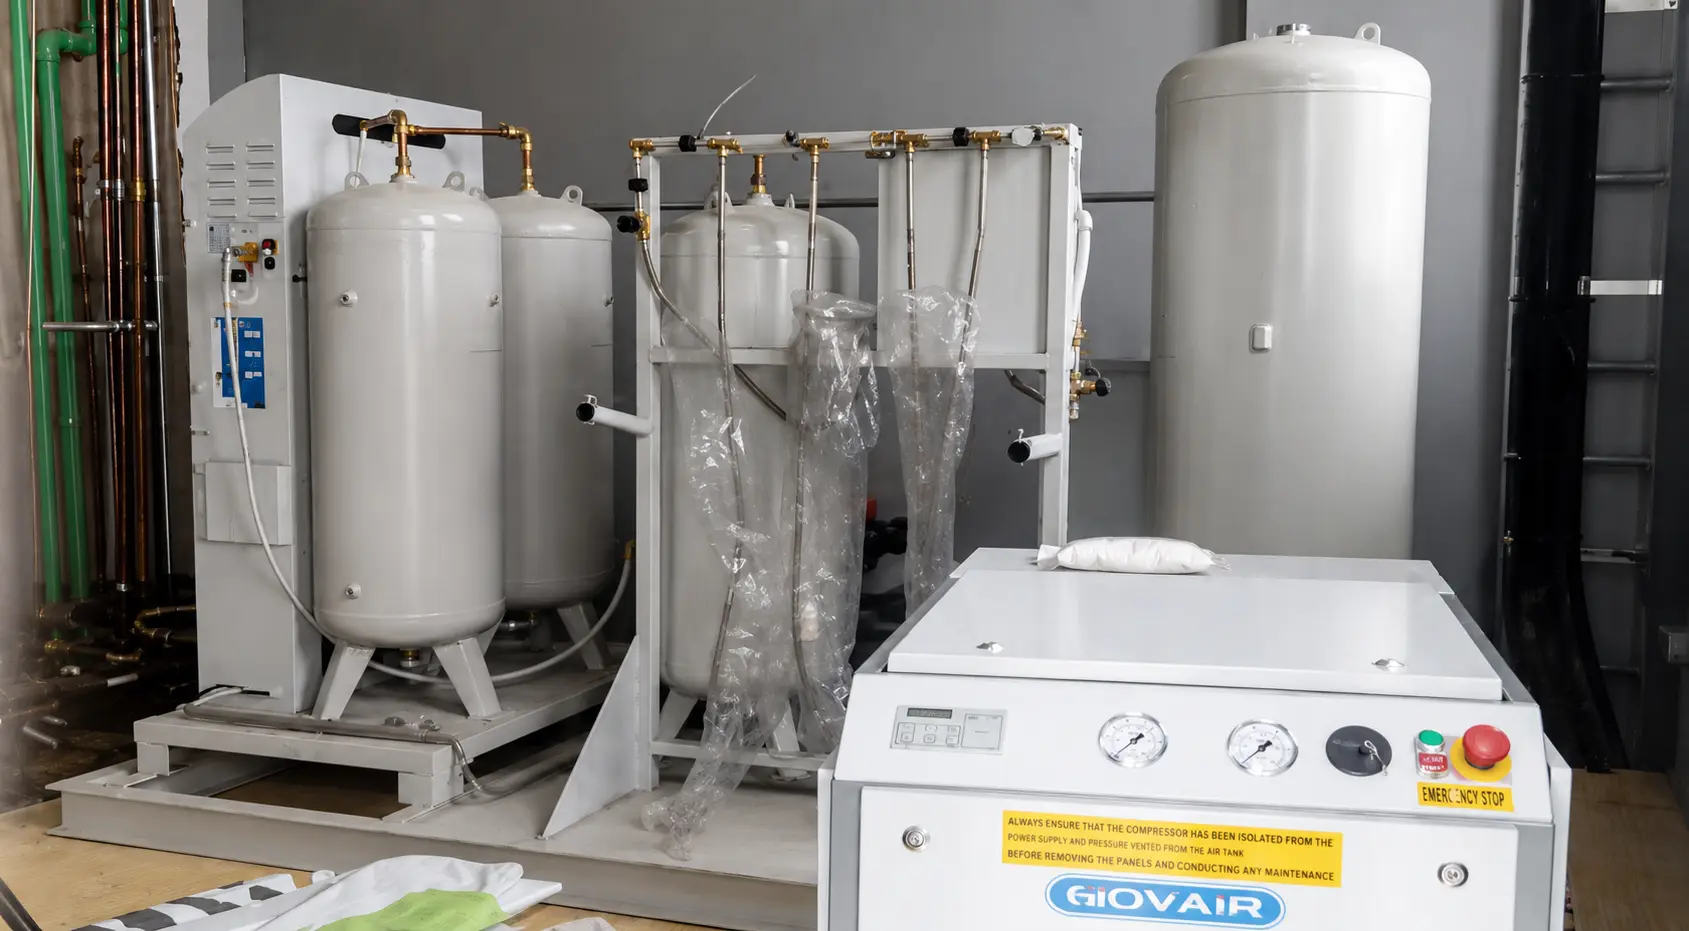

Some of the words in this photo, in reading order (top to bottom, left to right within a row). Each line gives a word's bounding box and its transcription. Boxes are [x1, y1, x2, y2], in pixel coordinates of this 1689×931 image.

[1481, 791, 1505, 806] STOP
[1008, 817, 1043, 828] ALWAYS
[1046, 820, 1080, 830] ENSURE
[1082, 822, 1105, 832] THAT
[1107, 823, 1124, 833] THE
[1126, 825, 1188, 838] COMPRESSOR
[1190, 830, 1209, 839] HAS
[1211, 831, 1235, 841] BEEN
[1238, 833, 1283, 844] ISOLATED
[1285, 836, 1313, 846] FROM
[1315, 838, 1333, 847] THE
[1008, 833, 1036, 842] POWER
[1038, 835, 1067, 845] SUPPLY
[1069, 838, 1086, 846] AND
[1088, 839, 1128, 849] PRESSURE
[1131, 842, 1161, 852] VENTED
[1164, 844, 1187, 853] FROM
[1190, 846, 1204, 855] THE
[1207, 847, 1221, 856] AIR
[1223, 848, 1244, 857] TANK
[1008, 850, 1042, 860] BEFORE
[1045, 852, 1094, 863] REMOVING
[1096, 856, 1114, 865] THE
[1117, 857, 1152, 868] PANELS
[1155, 860, 1175, 869] AND
[1177, 862, 1240, 874] CONDUCTING
[1242, 866, 1262, 875] ANY
[1265, 868, 1335, 881] MAINTENANCE
[1066, 885, 1263, 918] GIOVAIR
